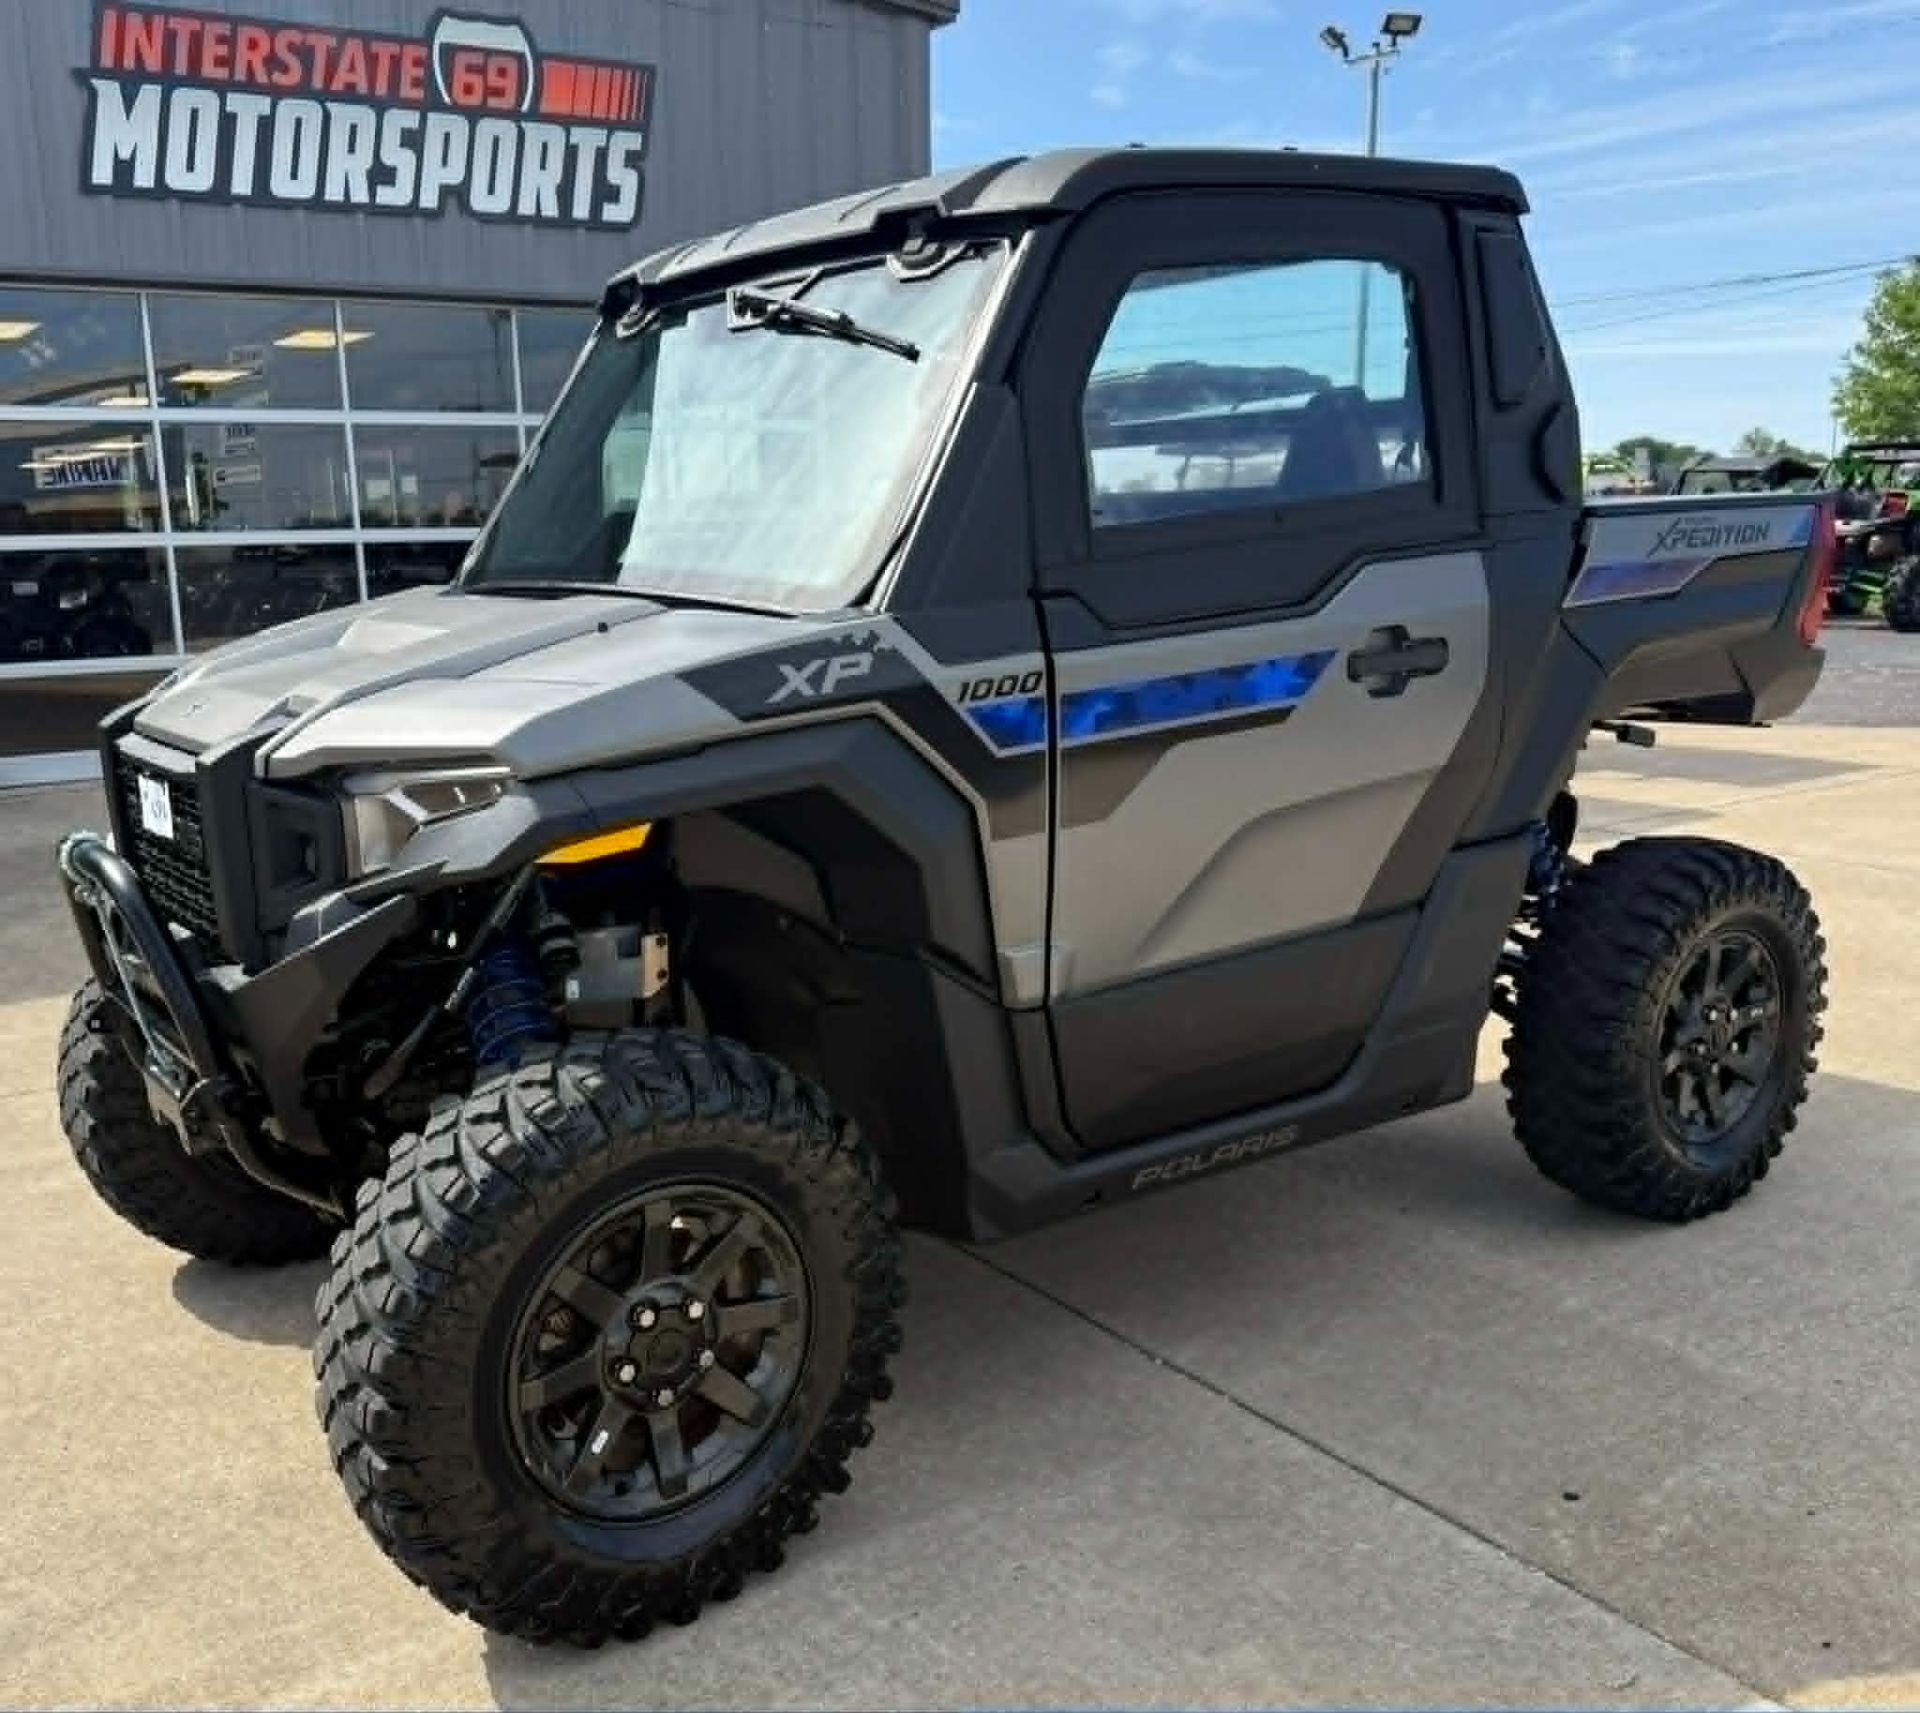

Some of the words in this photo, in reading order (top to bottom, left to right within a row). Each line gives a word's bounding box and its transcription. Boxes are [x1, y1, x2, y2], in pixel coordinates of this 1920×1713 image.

[99, 8, 428, 100] INTERSTATE
[452, 50, 518, 109] 69
[90, 78, 643, 224] MOTORSPORTS
[1646, 516, 1771, 558] XPEDITION
[765, 651, 873, 704] XP
[958, 670, 1043, 703] 1000
[1131, 1124, 1299, 1191] POLARIS
